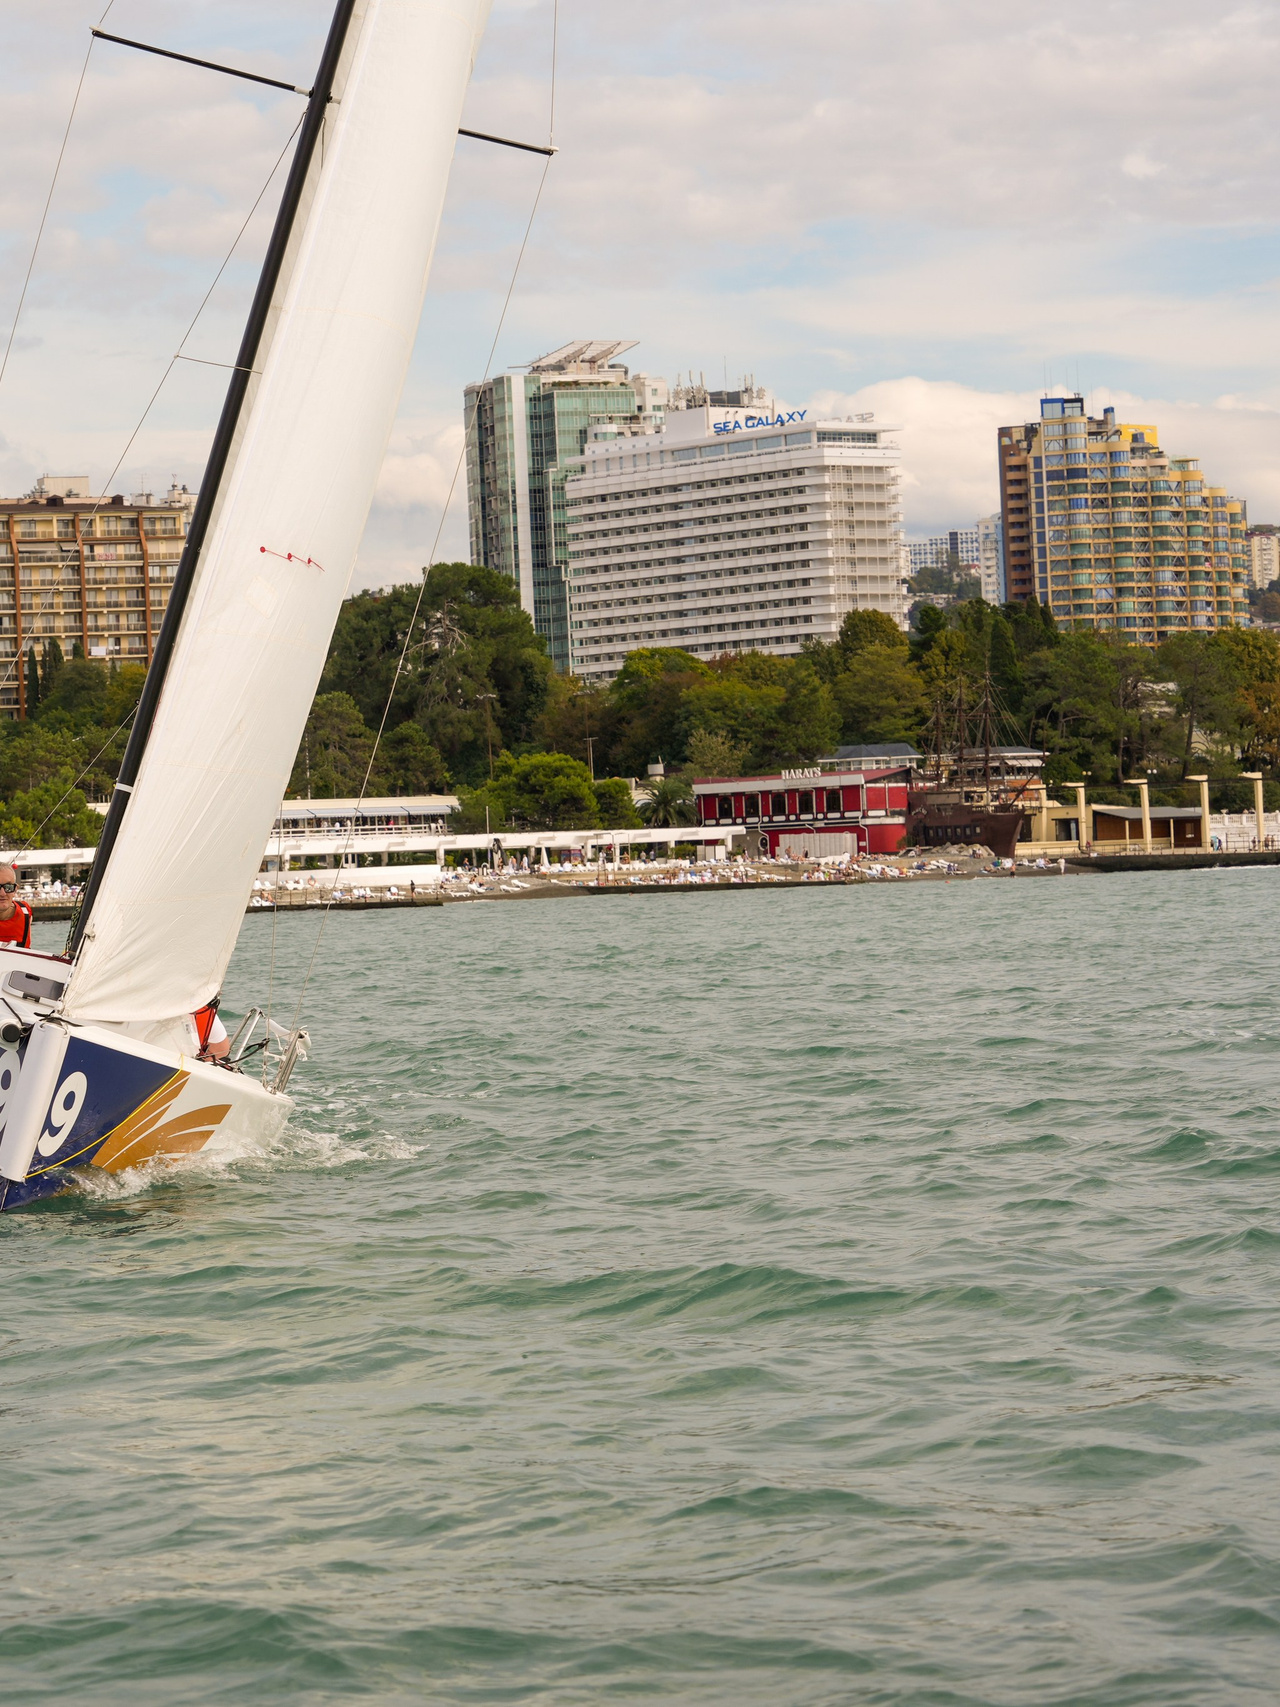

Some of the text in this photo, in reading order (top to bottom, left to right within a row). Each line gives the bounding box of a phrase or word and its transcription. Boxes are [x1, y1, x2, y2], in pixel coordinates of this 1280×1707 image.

[713, 409, 808, 434] SEA GALAXY
[37, 1071, 88, 1157] 9
